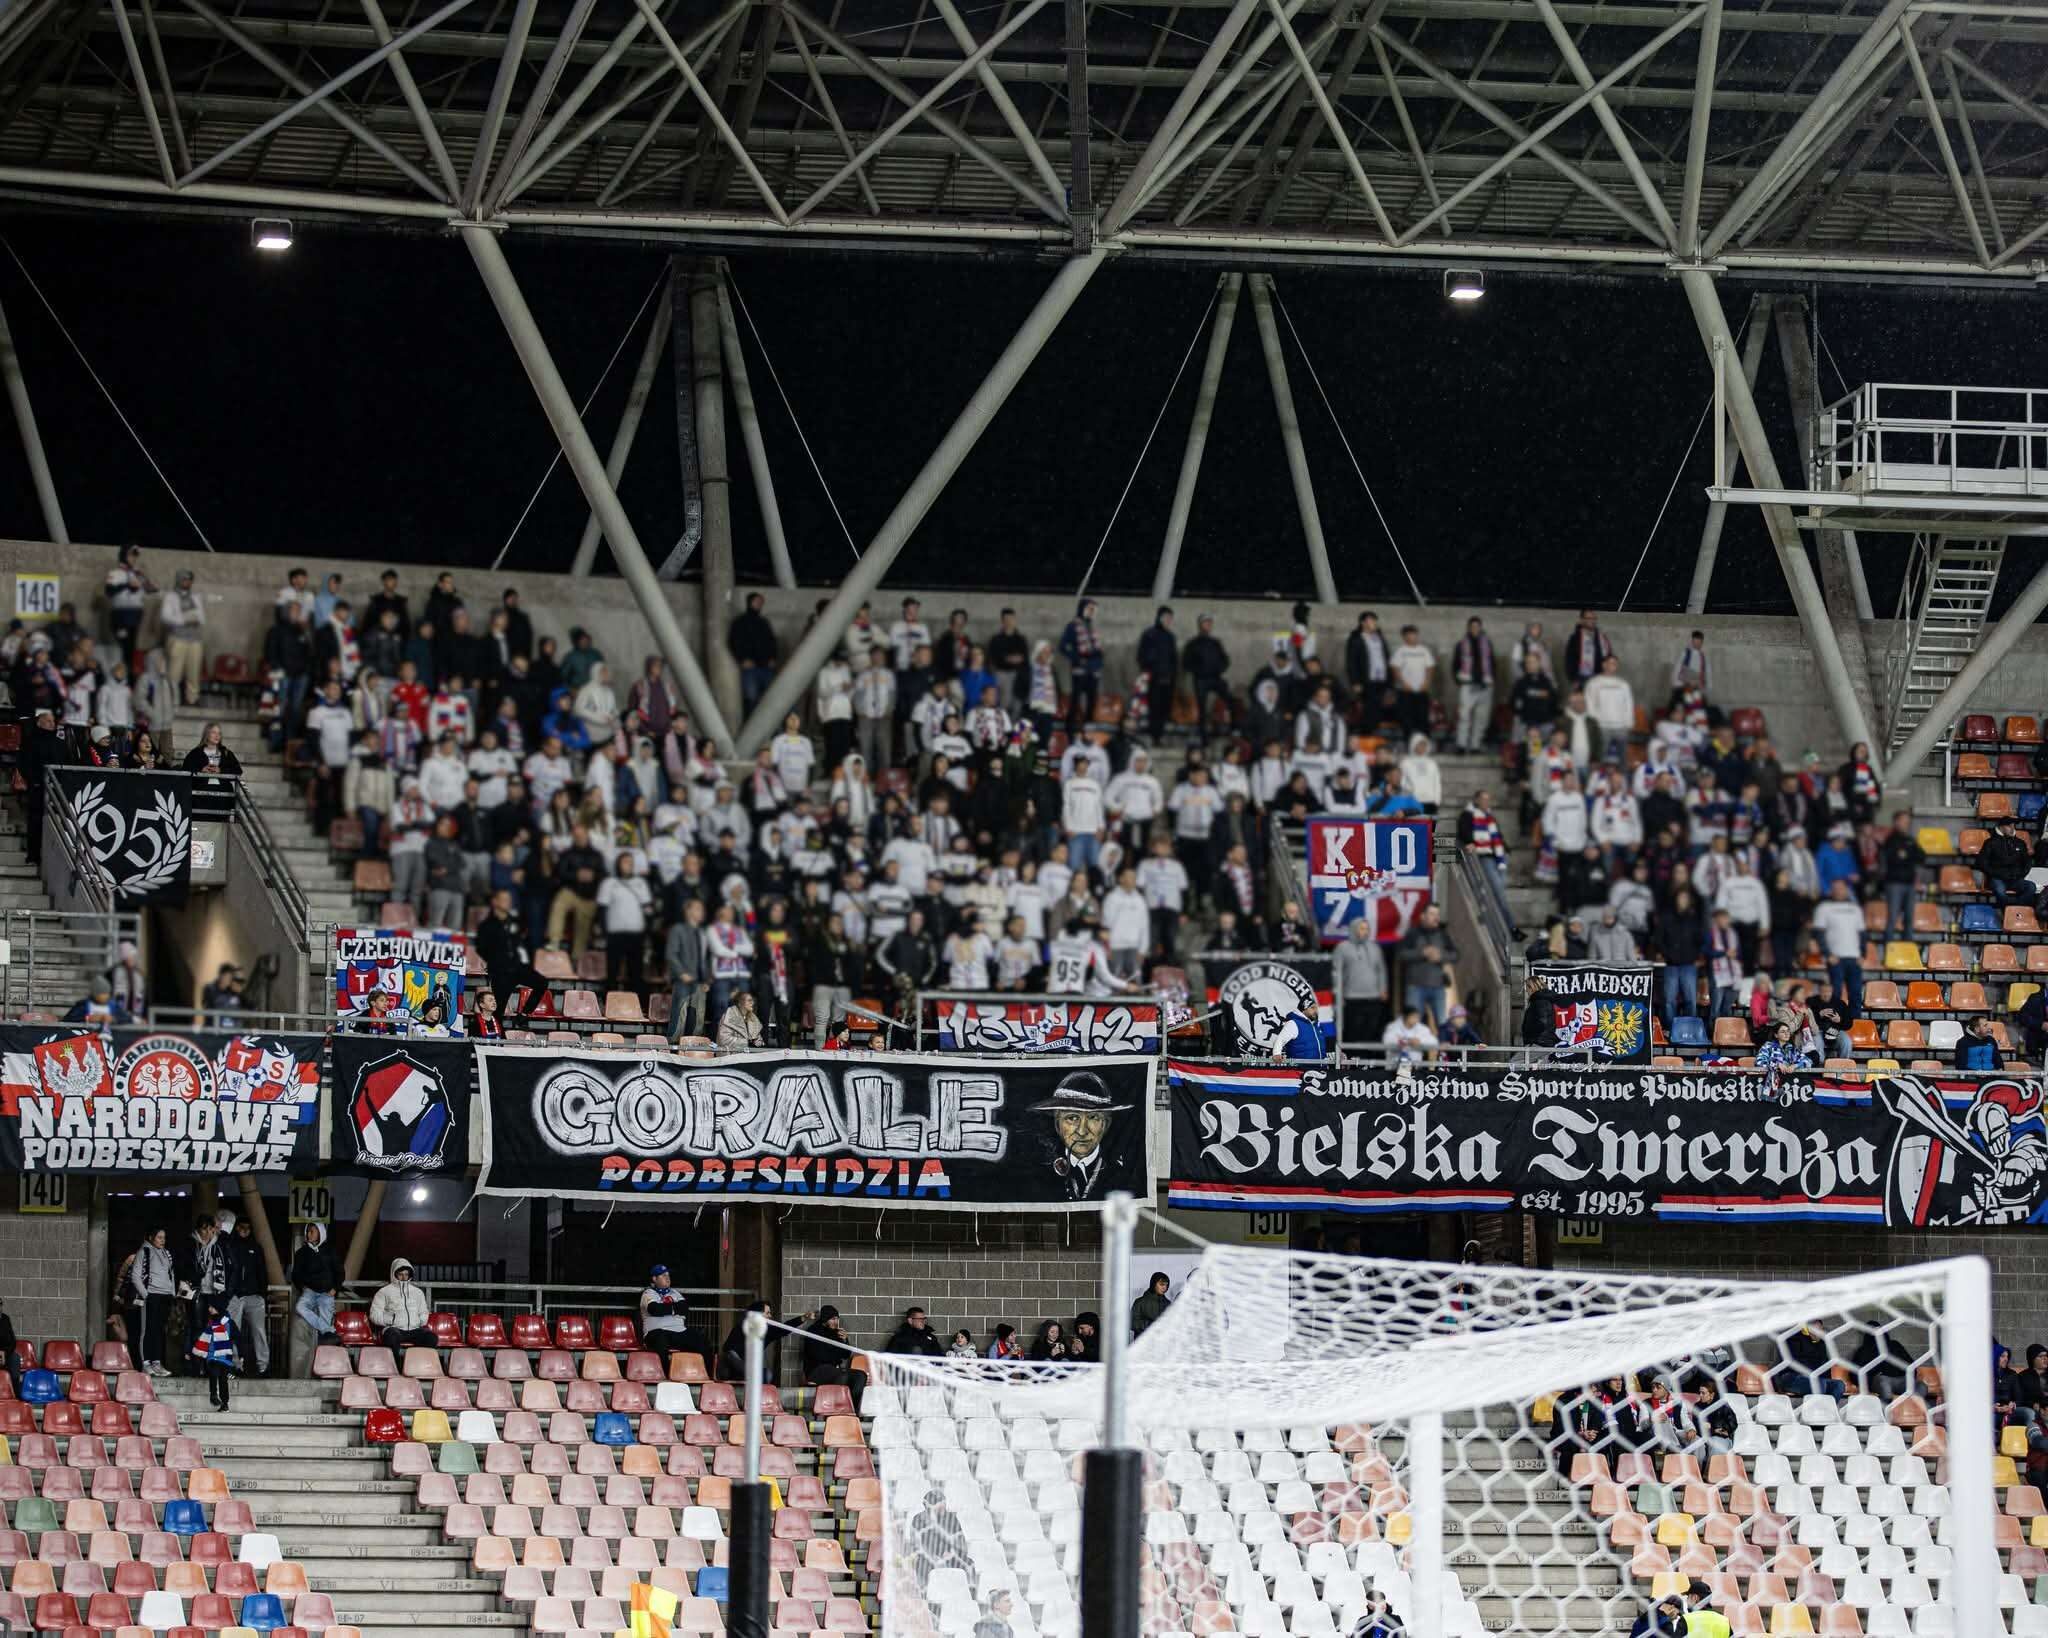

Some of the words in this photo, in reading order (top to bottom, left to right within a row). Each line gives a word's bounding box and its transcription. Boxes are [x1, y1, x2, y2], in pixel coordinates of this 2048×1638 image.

[19, 581, 55, 613] 14G
[88, 803, 163, 868] 95
[341, 938, 464, 966] CZECHOWICE
[1056, 958, 1081, 983] 95
[1224, 967, 1263, 1004] GOOD
[1269, 966, 1313, 998] NIGH
[116, 1038, 213, 1081] NARODOWE
[1237, 1036, 1271, 1058] EFT
[1303, 1070, 1490, 1105] Towarzystwo
[1496, 1071, 1635, 1105] Sportowe
[1640, 1074, 1813, 1107] Podbeskizie
[19, 1096, 300, 1146] NARODOWE
[540, 1061, 1004, 1154] GÓRALE
[23, 1138, 293, 1173] PODBESKIDZIE
[1200, 1100, 1502, 1183] Bielska
[1528, 1105, 1880, 1198] Twierdza
[22, 1174, 64, 1206] 14D
[600, 1155, 951, 1198] PODBESKIDZIA
[292, 1185, 329, 1216] 14D
[1521, 1190, 1565, 1214] est.
[1574, 1189, 1646, 1216] 1995
